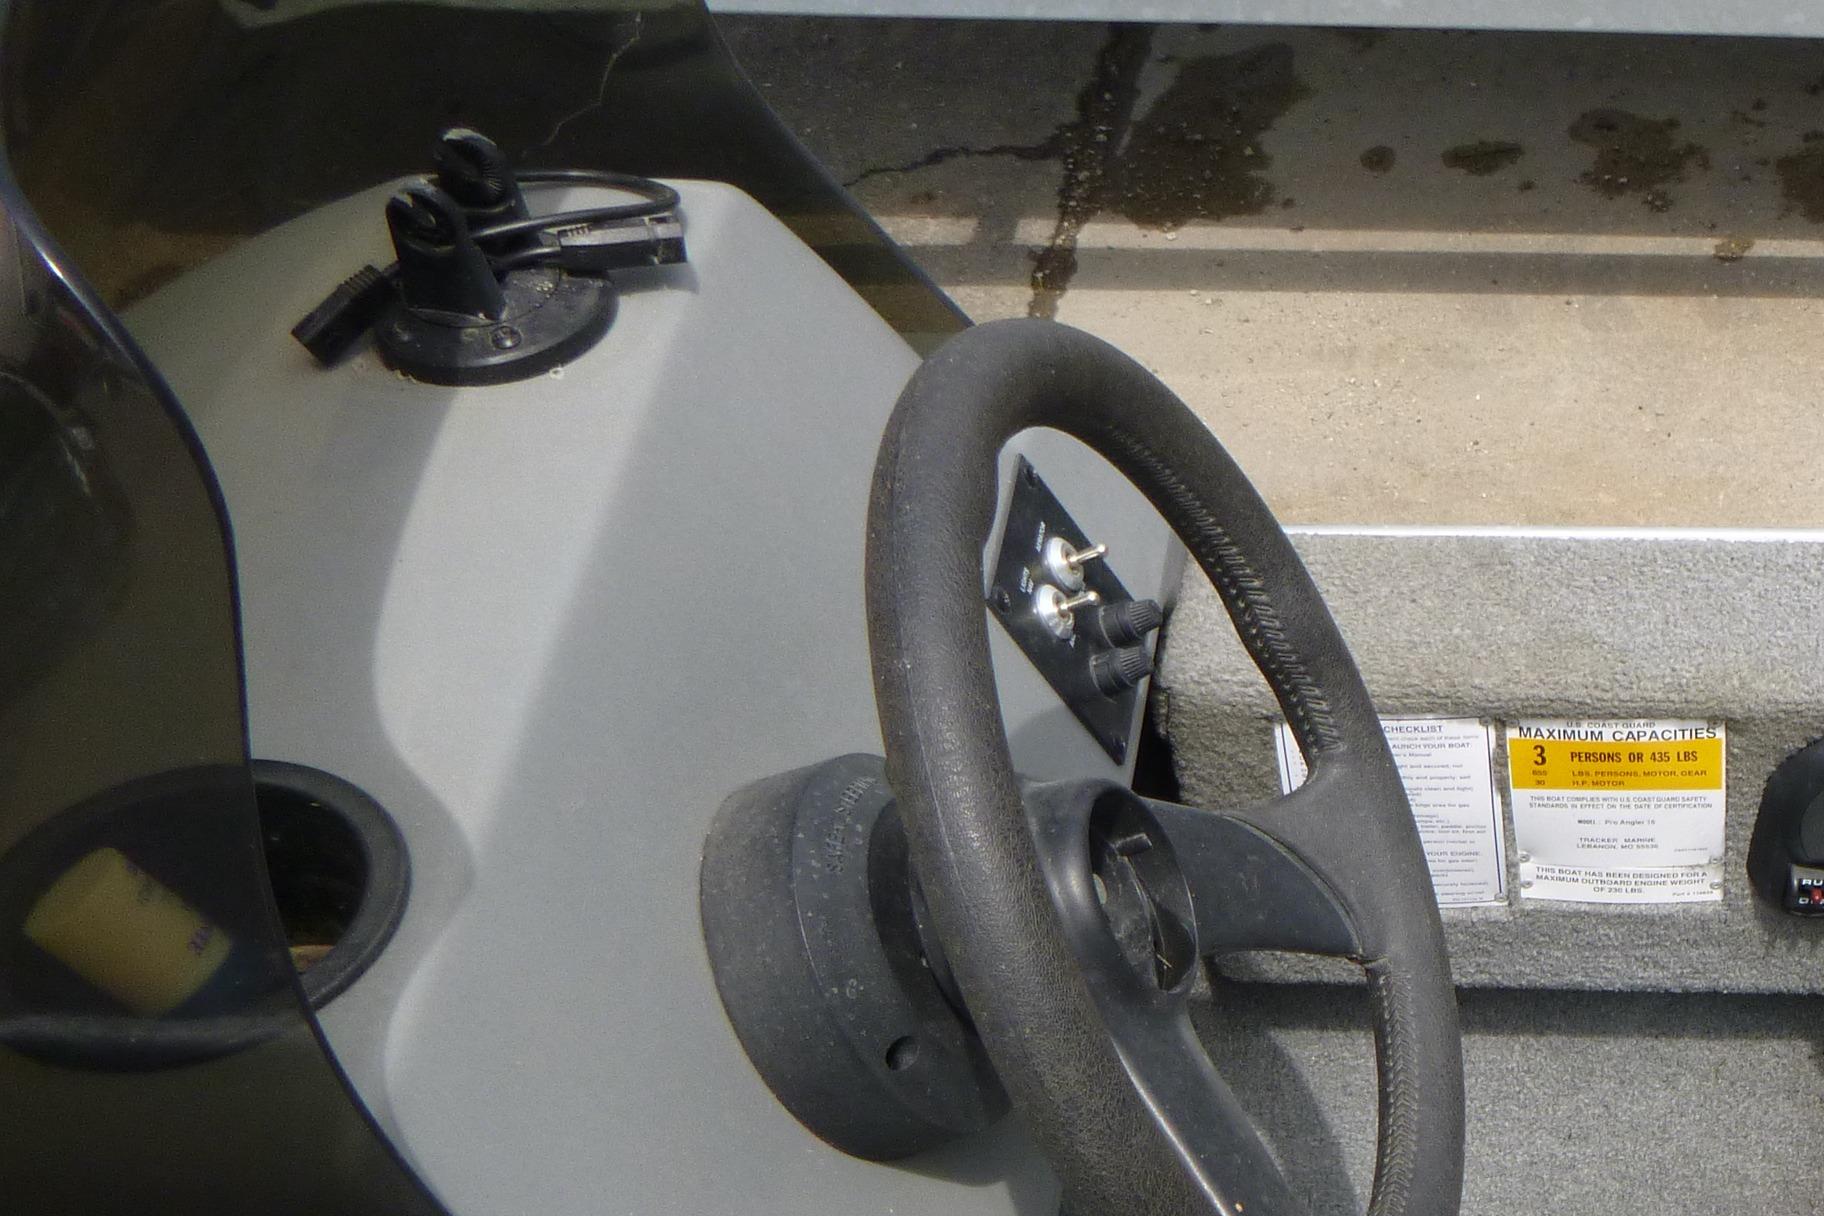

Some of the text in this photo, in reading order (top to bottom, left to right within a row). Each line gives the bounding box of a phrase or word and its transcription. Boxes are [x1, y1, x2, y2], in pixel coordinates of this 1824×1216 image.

[1383, 725, 1443, 733] CHECKLIST
[1518, 727, 1716, 742] MAXIMUM CAPACITIES
[1533, 744, 1698, 766] 3 PERSONS OR 435 LBS
[1536, 866, 1556, 874] THIS
[1584, 870, 1603, 878] HAS
[1536, 874, 1580, 883] MAXIMUM
[1581, 878, 1632, 886] OUTBOARD
